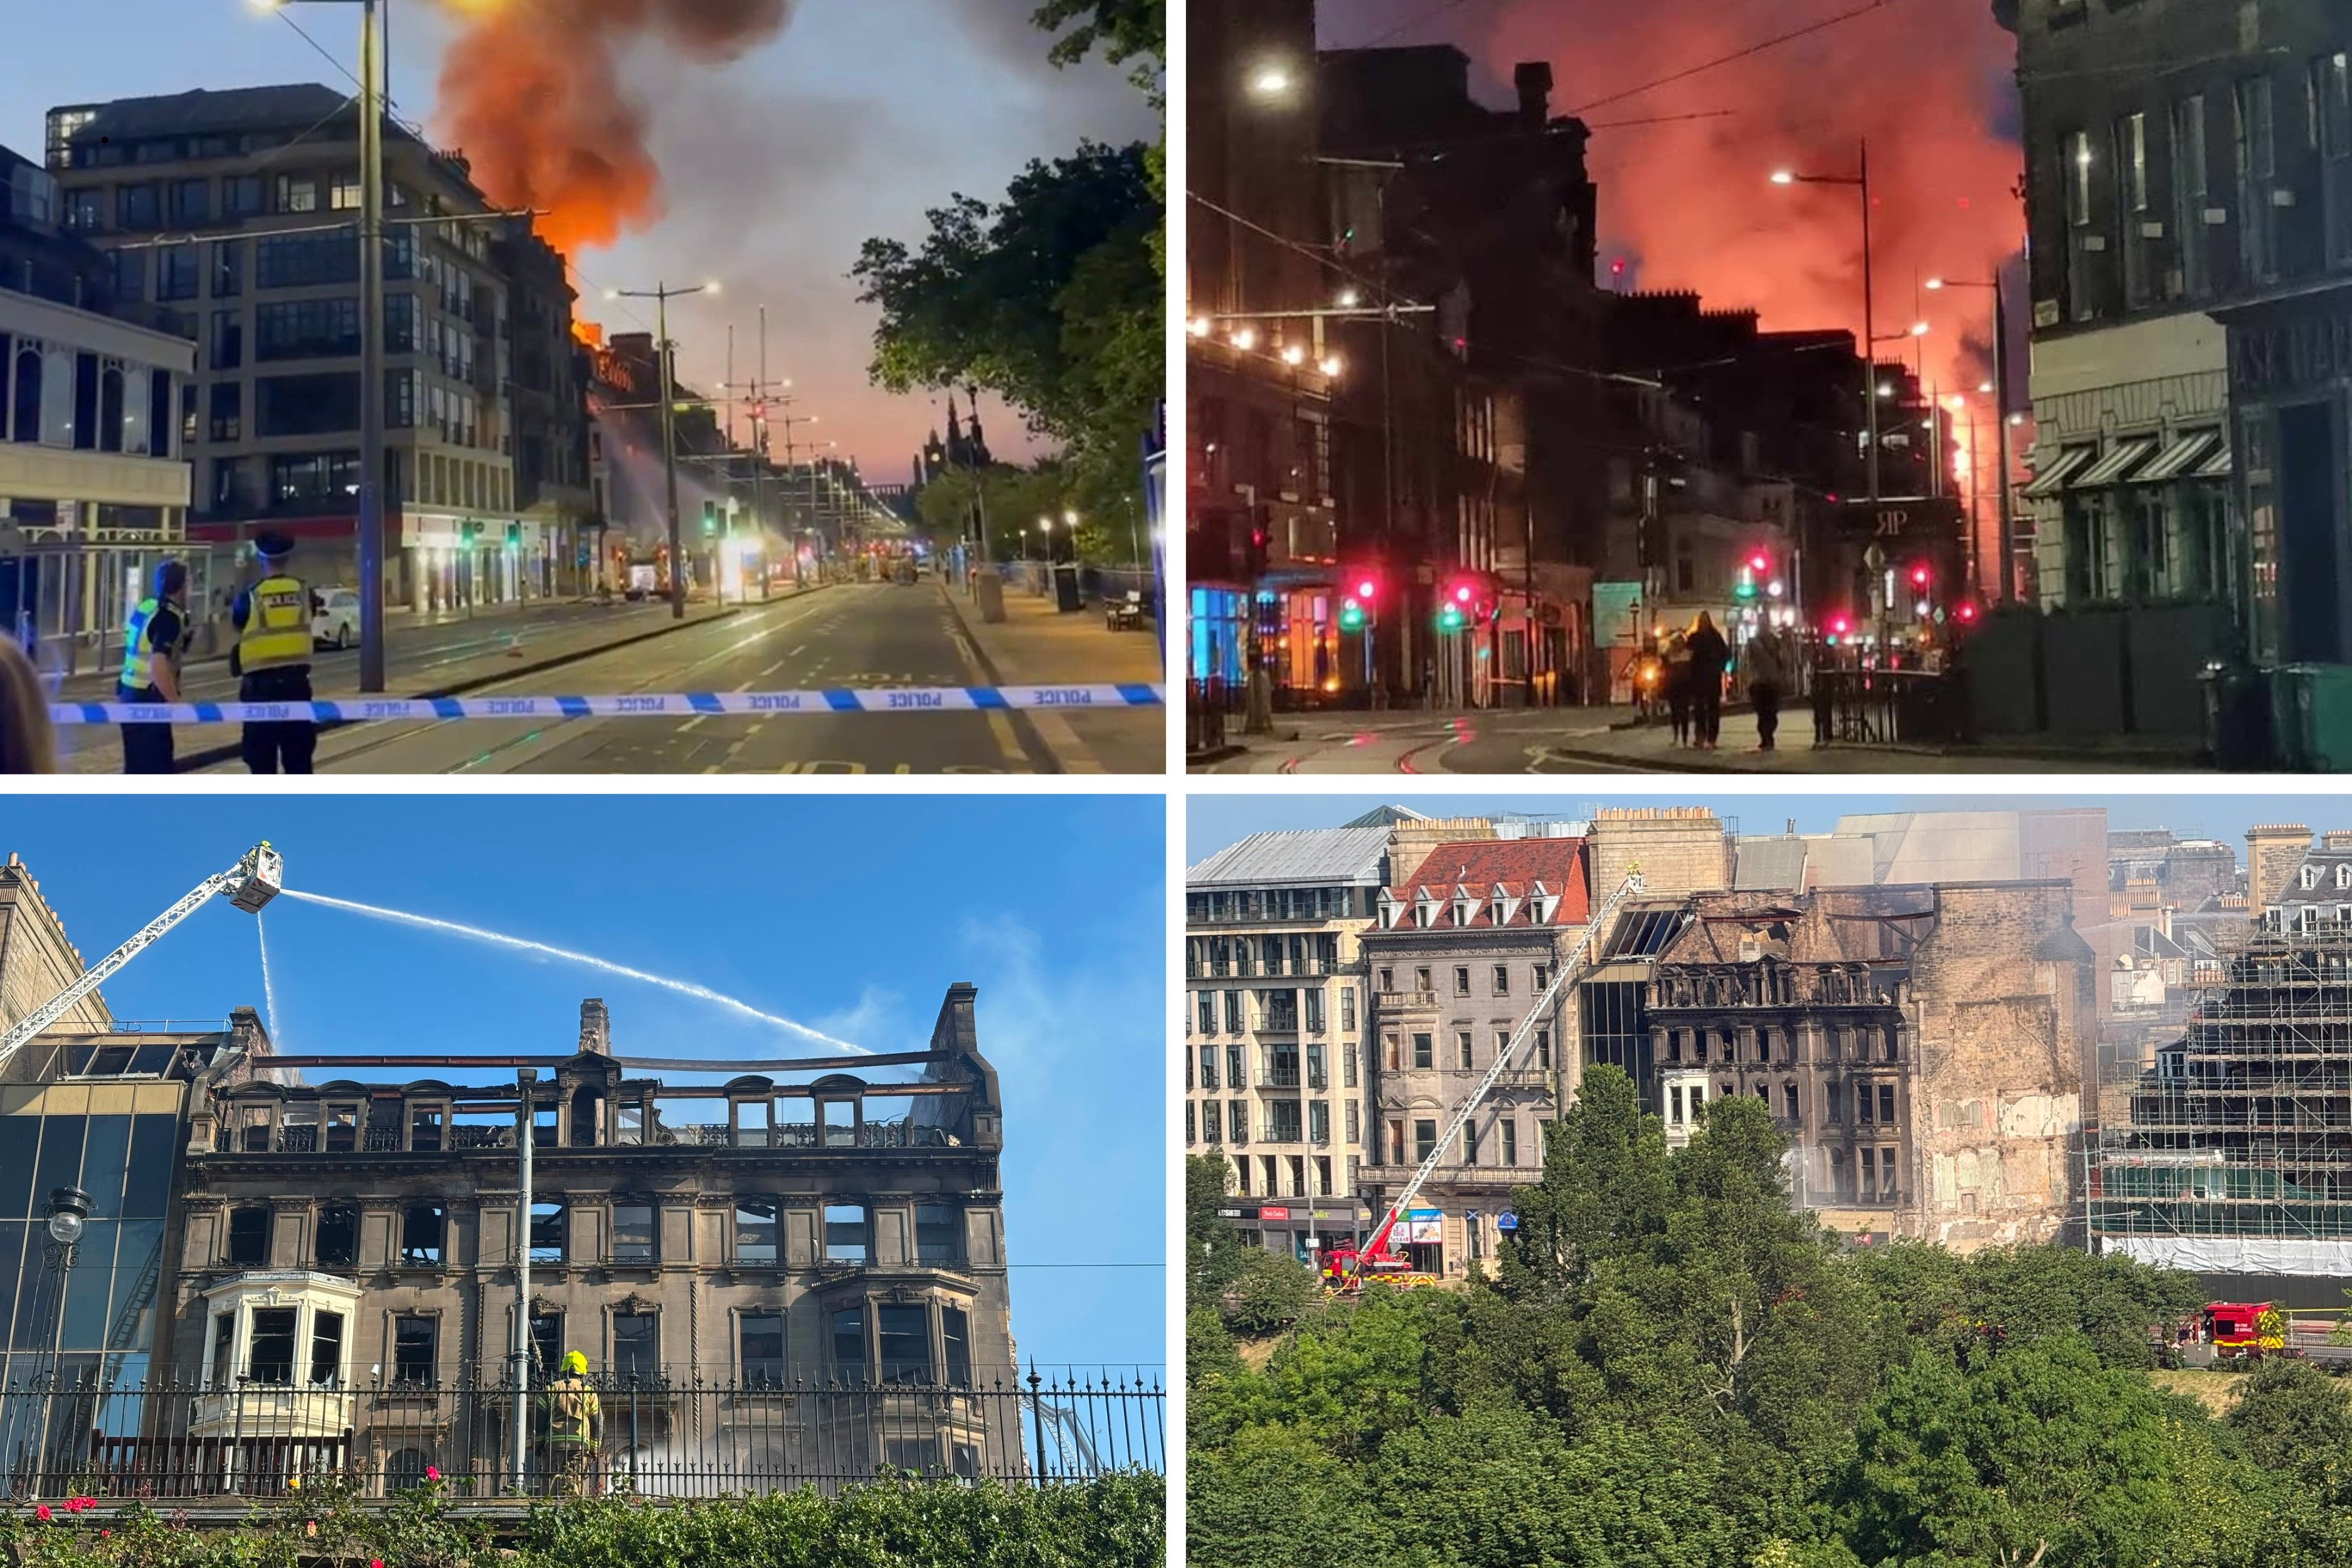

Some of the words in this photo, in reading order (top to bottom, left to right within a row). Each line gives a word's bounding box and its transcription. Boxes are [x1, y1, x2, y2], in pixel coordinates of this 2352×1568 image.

[616, 697, 665, 712] POLICE
[748, 695, 800, 709] POLICE
[889, 693, 941, 707] POLICE
[1035, 690, 1091, 705] POLICE
[245, 704, 289, 718] POLICE
[363, 702, 410, 717] POLICE
[487, 700, 534, 714] POLICE
